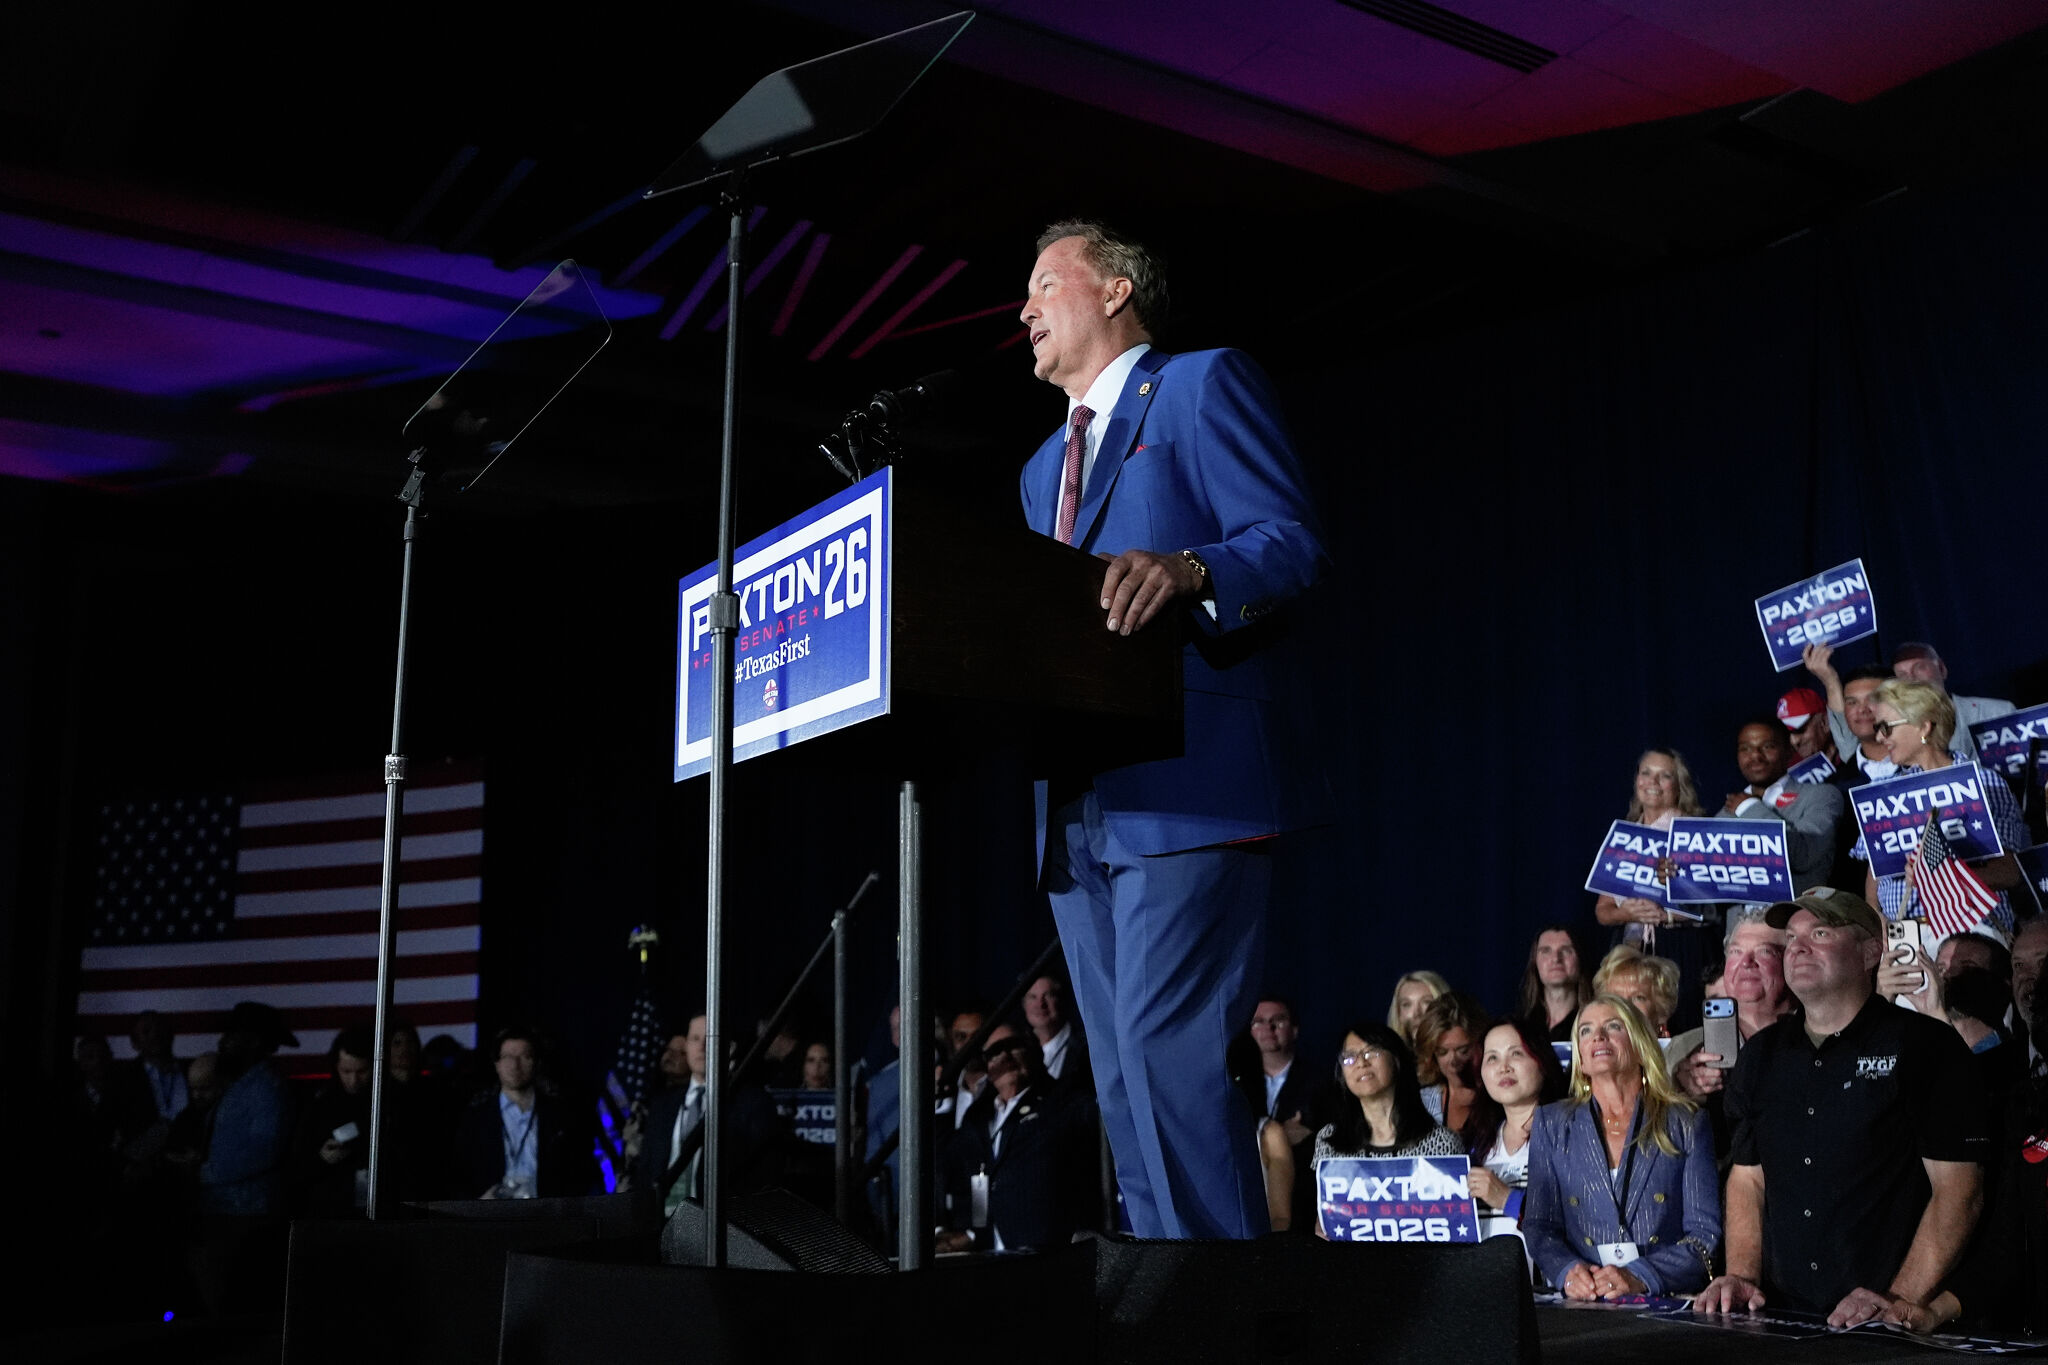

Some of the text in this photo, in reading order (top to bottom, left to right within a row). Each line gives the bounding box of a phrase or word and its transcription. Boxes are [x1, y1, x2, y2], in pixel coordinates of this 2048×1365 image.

[692, 527, 868, 652] PXTON 26
[1762, 572, 1866, 626] PAXTON
[740, 609, 808, 652] SENATE
[1787, 605, 1857, 646] 2026
[735, 633, 811, 683] #TexasFirst
[1975, 717, 2048, 750] PAX
[1857, 778, 1980, 824] PAXTON
[1899, 801, 1984, 826] SEATE
[1609, 831, 1667, 859] PAX
[1672, 831, 1783, 856] PAXTON
[1881, 818, 1967, 854] 206
[1615, 860, 1667, 890] 20
[1690, 864, 1770, 886] 2026
[777, 1105, 836, 1120] XTO
[1322, 1175, 1470, 1202] PAXTON
[1380, 1203, 1472, 1216] SENATE
[1350, 1218, 1451, 1242] 2026
